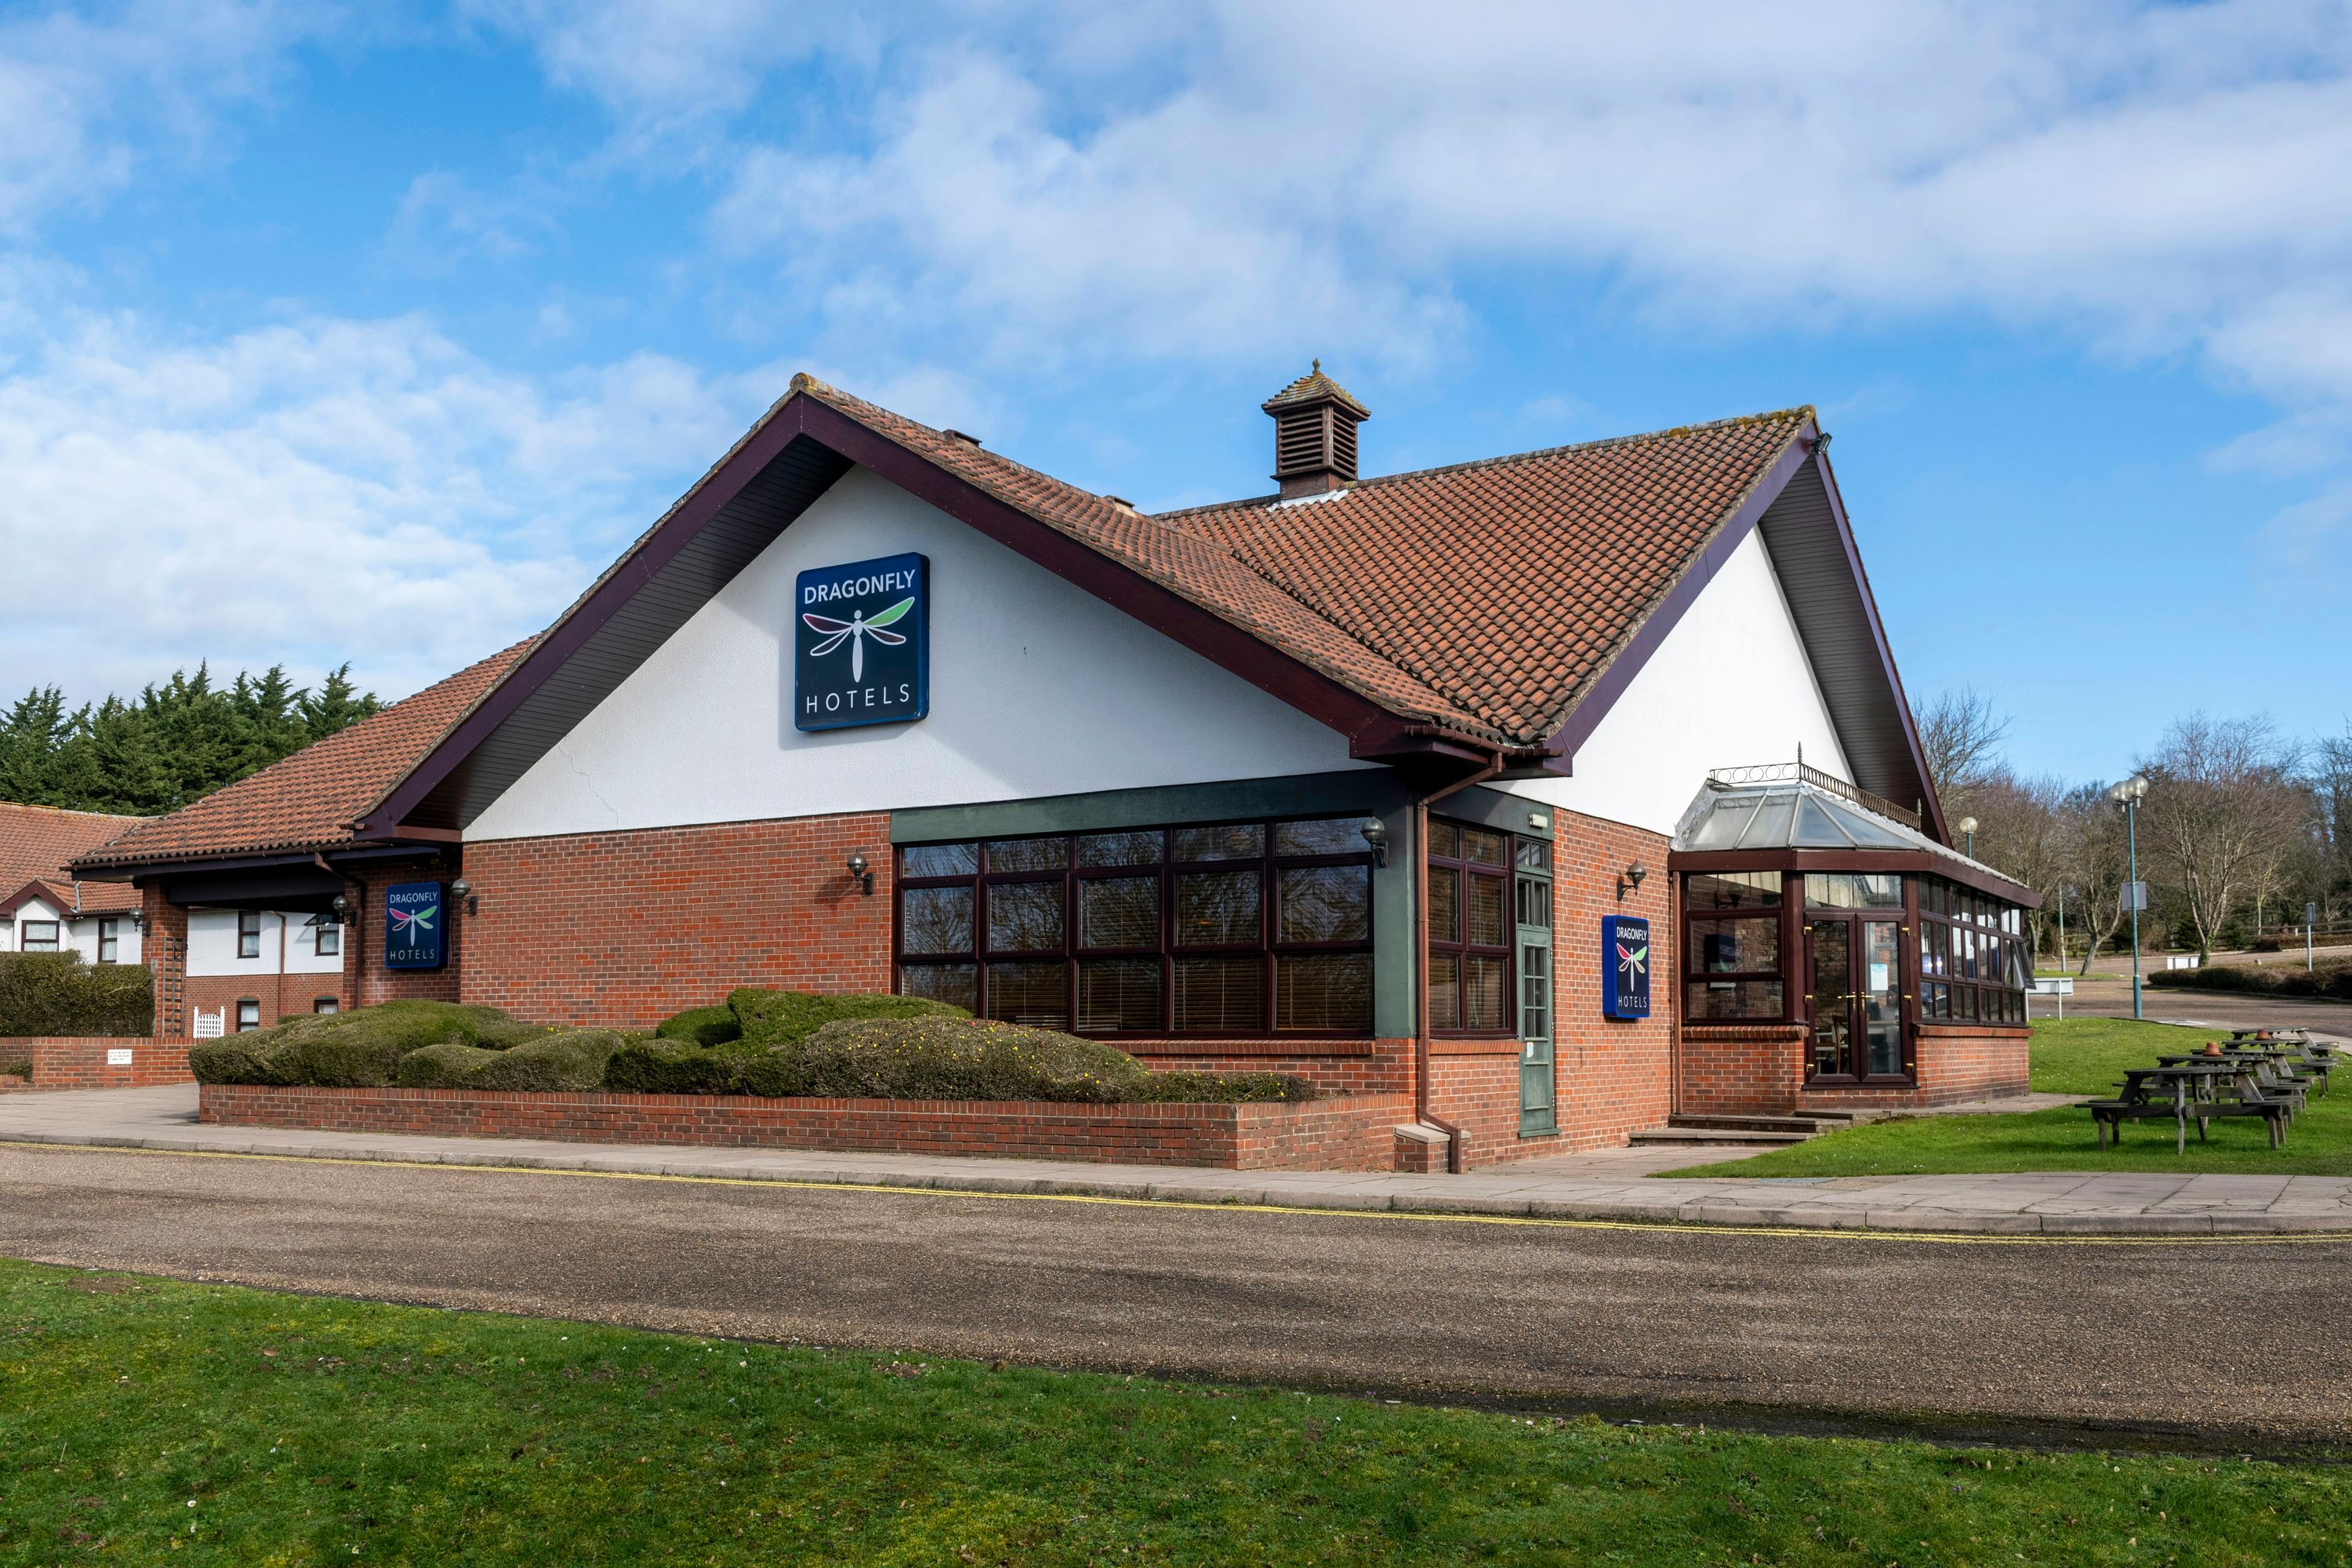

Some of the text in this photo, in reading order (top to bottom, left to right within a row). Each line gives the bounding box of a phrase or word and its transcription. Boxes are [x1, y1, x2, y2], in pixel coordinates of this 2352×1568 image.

[804, 569, 916, 604] DRAGONFLY
[806, 684, 909, 713] HOTELS
[390, 891, 437, 903] DRAGONFLY
[1617, 926, 1647, 941] DRAGONFLY
[390, 949, 434, 960] HOTELS
[1617, 996, 1647, 1007] HOTELS
